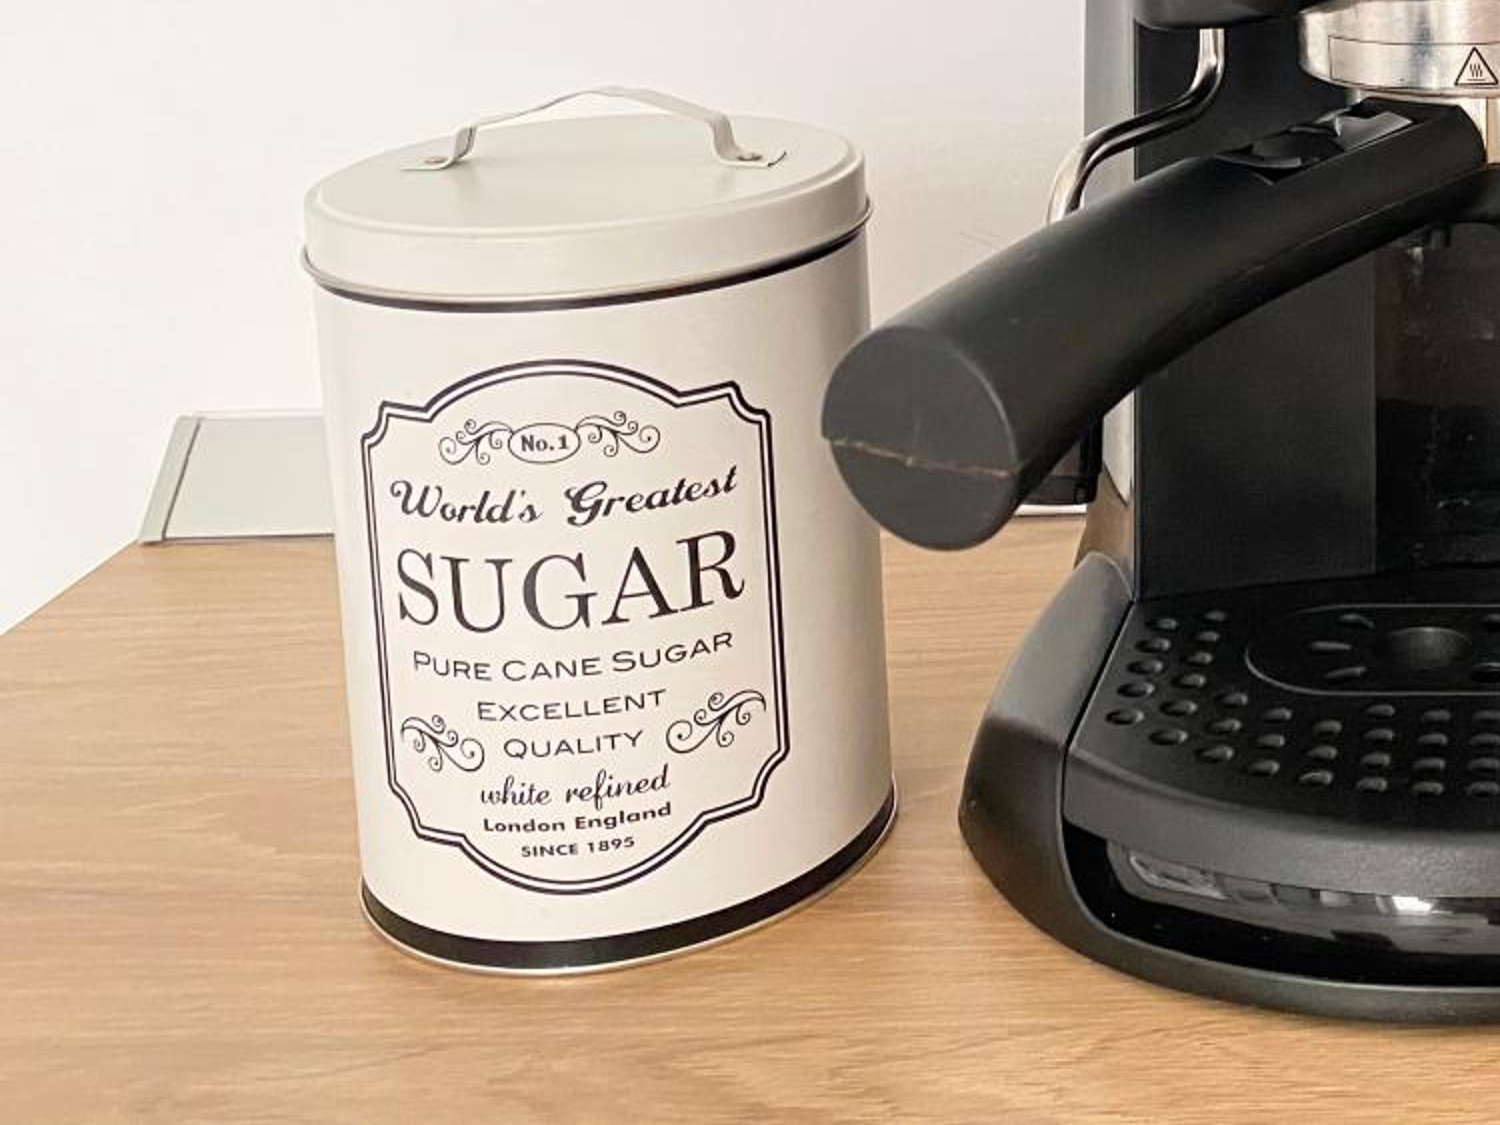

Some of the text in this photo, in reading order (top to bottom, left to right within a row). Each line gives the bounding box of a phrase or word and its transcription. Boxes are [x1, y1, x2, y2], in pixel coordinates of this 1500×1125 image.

[389, 465, 739, 526] World's Greatest
[397, 529, 746, 634] SUGAR
[413, 630, 735, 682] PURE CANE SUGAR
[477, 688, 668, 722] EXCELLENT
[502, 730, 645, 759] QUALITY
[480, 762, 671, 811] white refined
[483, 801, 672, 833] London England
[521, 836, 636, 858] SINCE 1895
